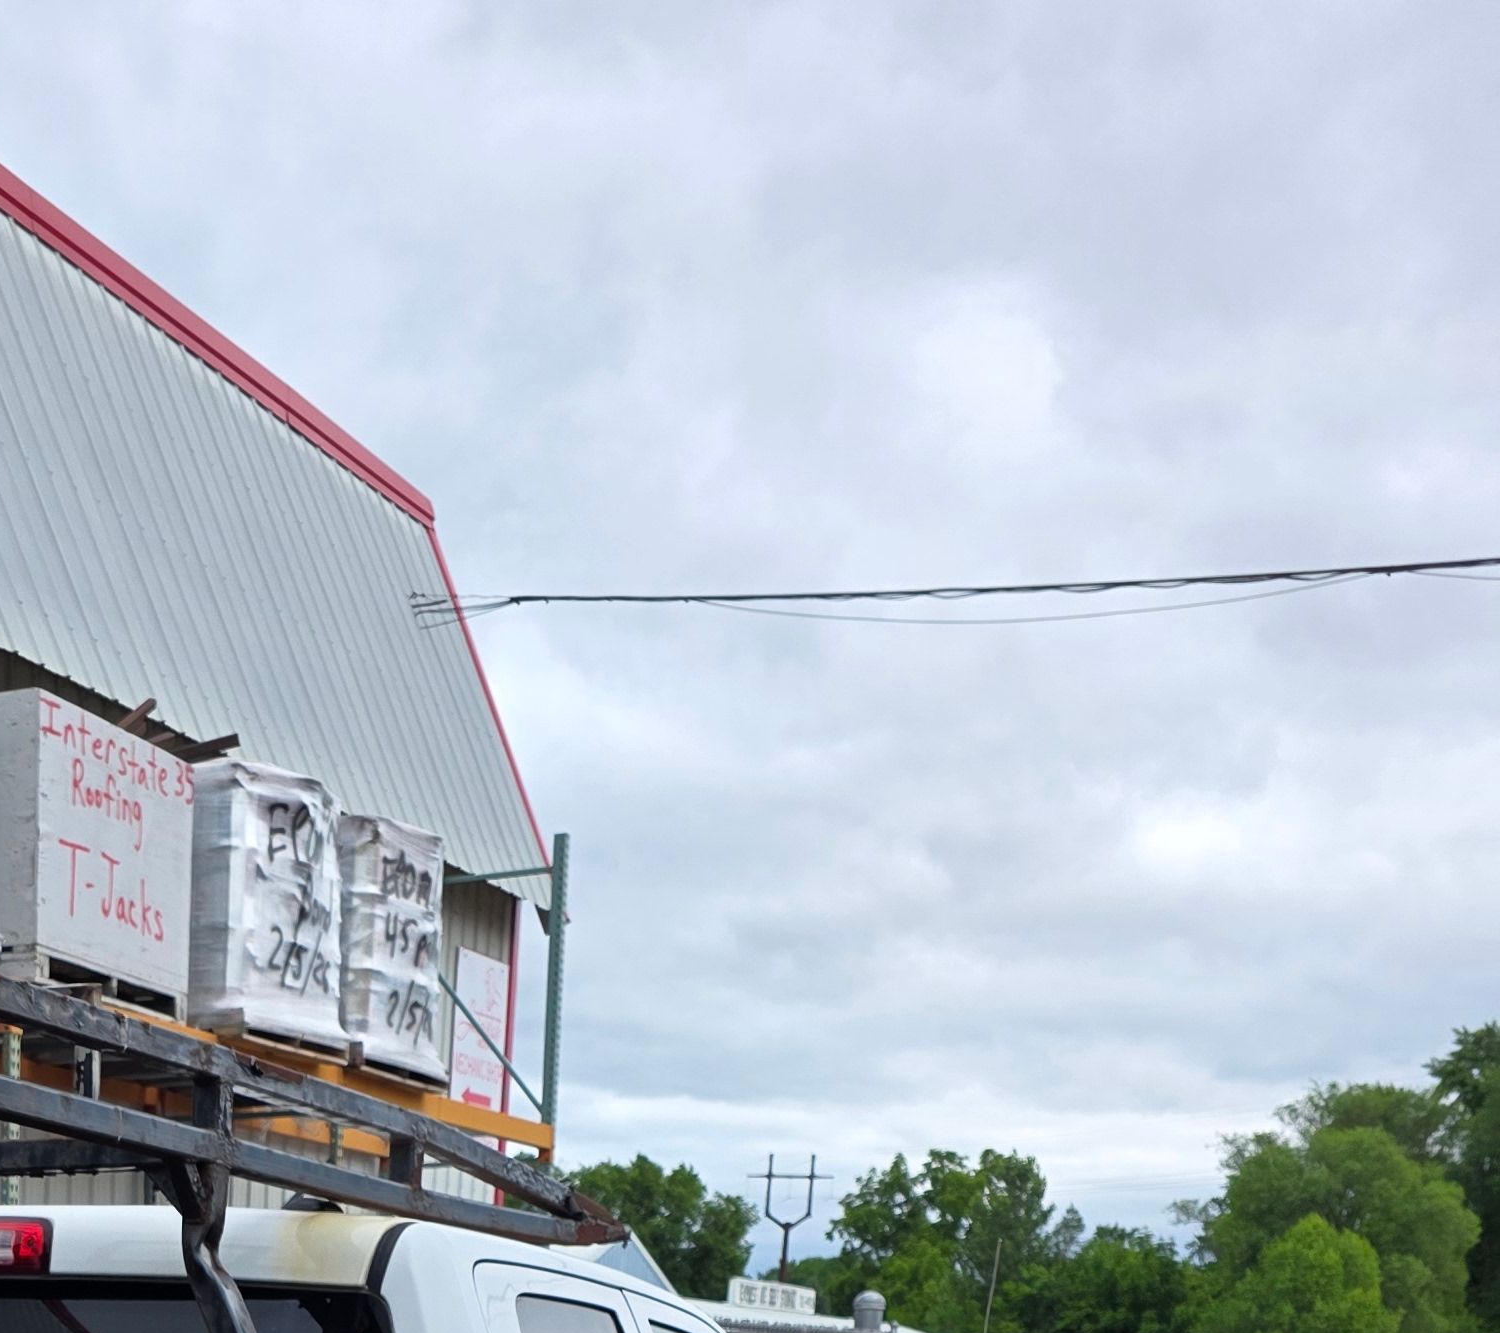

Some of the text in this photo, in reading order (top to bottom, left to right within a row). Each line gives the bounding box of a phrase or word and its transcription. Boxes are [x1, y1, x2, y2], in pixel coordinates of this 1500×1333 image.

[39, 697, 197, 806] Interstate 35
[72, 757, 143, 852] Roofing
[58, 838, 165, 942] T-Jacks
